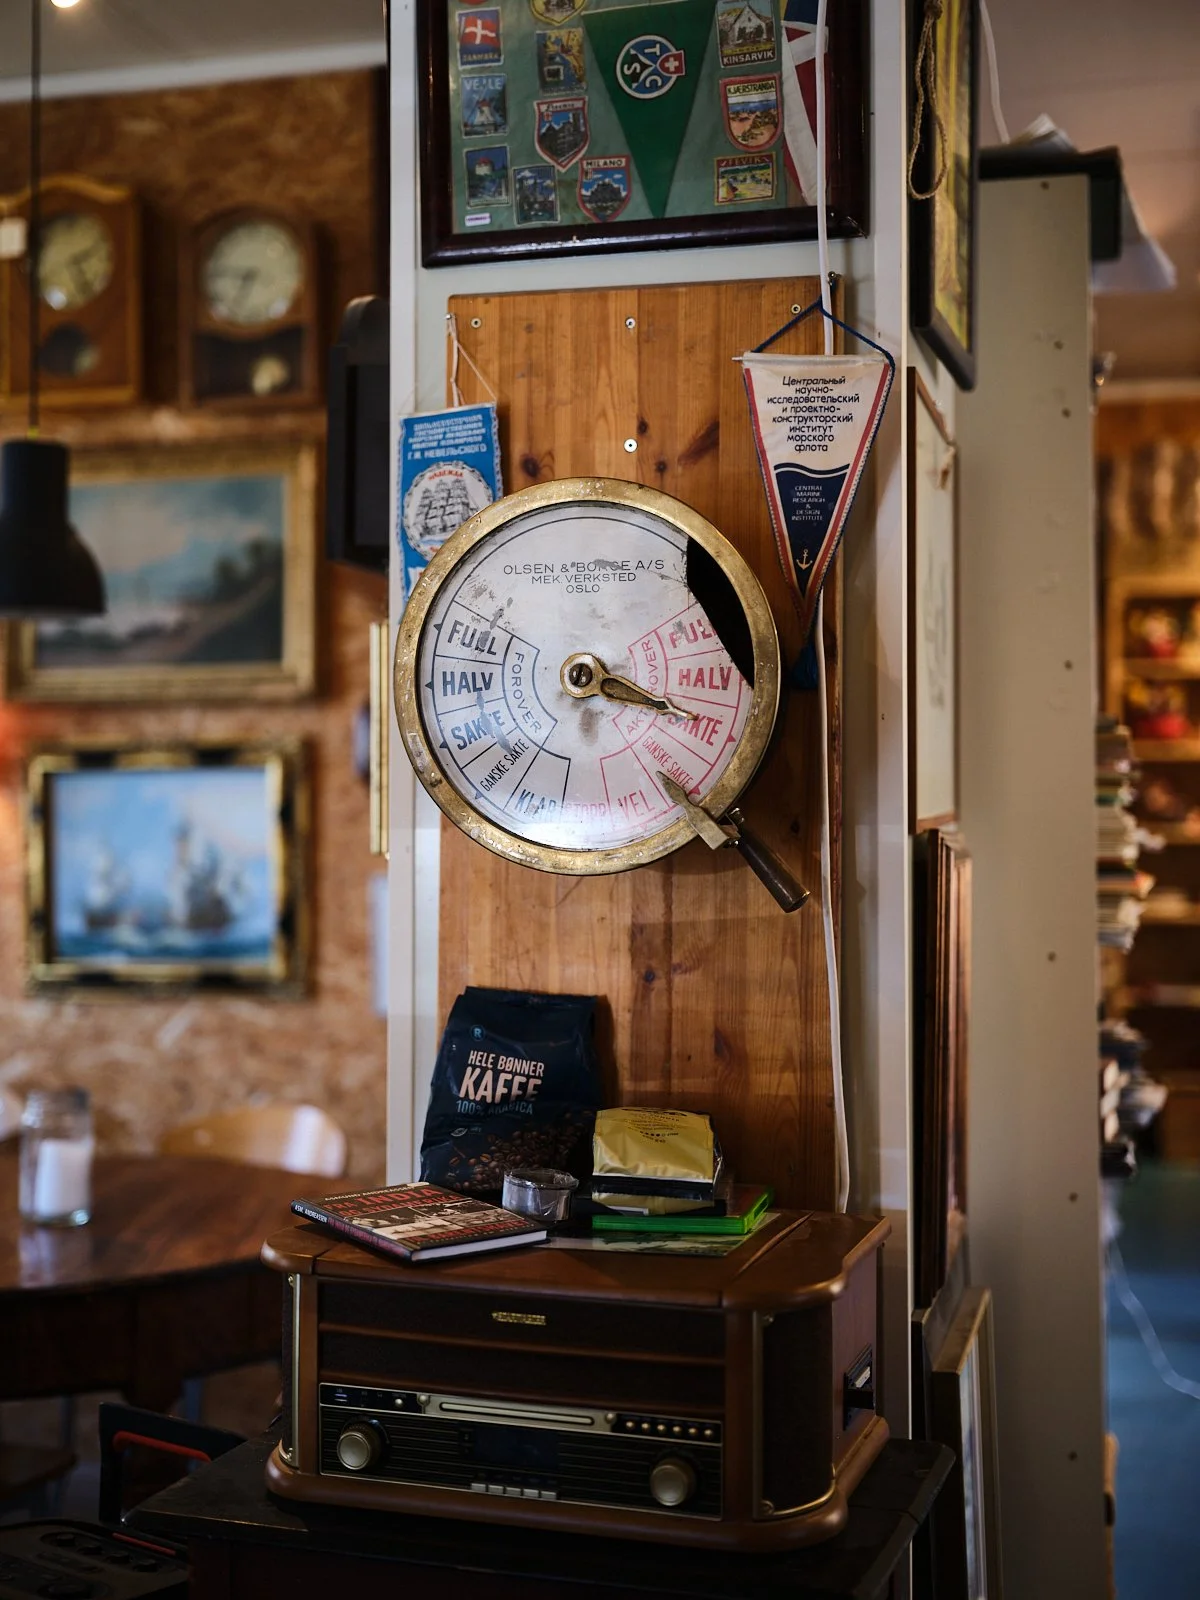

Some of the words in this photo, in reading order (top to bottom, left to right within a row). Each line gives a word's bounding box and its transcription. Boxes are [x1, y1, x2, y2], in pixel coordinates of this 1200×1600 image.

[722, 50, 774, 65] KINSARVIK
[586, 159, 624, 168] MILANO
[782, 376, 846, 387] Центральный
[795, 386, 834, 395] научно-
[767, 393, 860, 404] исследовательский
[790, 405, 841, 414] проектно-
[772, 413, 853, 424] конструкторский
[789, 425, 833, 434] институт
[787, 434, 834, 443] морского
[794, 444, 828, 453] флота
[503, 563, 553, 575] OLSEN
[560, 563, 570, 573] &
[635, 559, 664, 570] A/S
[564, 572, 636, 583] VERKSTED
[566, 584, 600, 593] OSLO
[447, 619, 497, 655] FULL
[442, 671, 493, 696] HALV
[679, 666, 732, 690] HALV
[511, 652, 542, 734] FOROVER
[480, 761, 510, 792] GANSKE
[504, 738, 530, 766] SAKTE
[641, 736, 673, 769] GANSKE
[667, 762, 694, 788] SAKTE
[618, 789, 655, 820] VEL
[474, 1028, 482, 1038] R
[468, 1050, 496, 1068] HELE
[497, 1055, 544, 1077] BØNNER
[459, 1066, 542, 1104] KAFFE
[357, 1189, 443, 1205] INDIA
